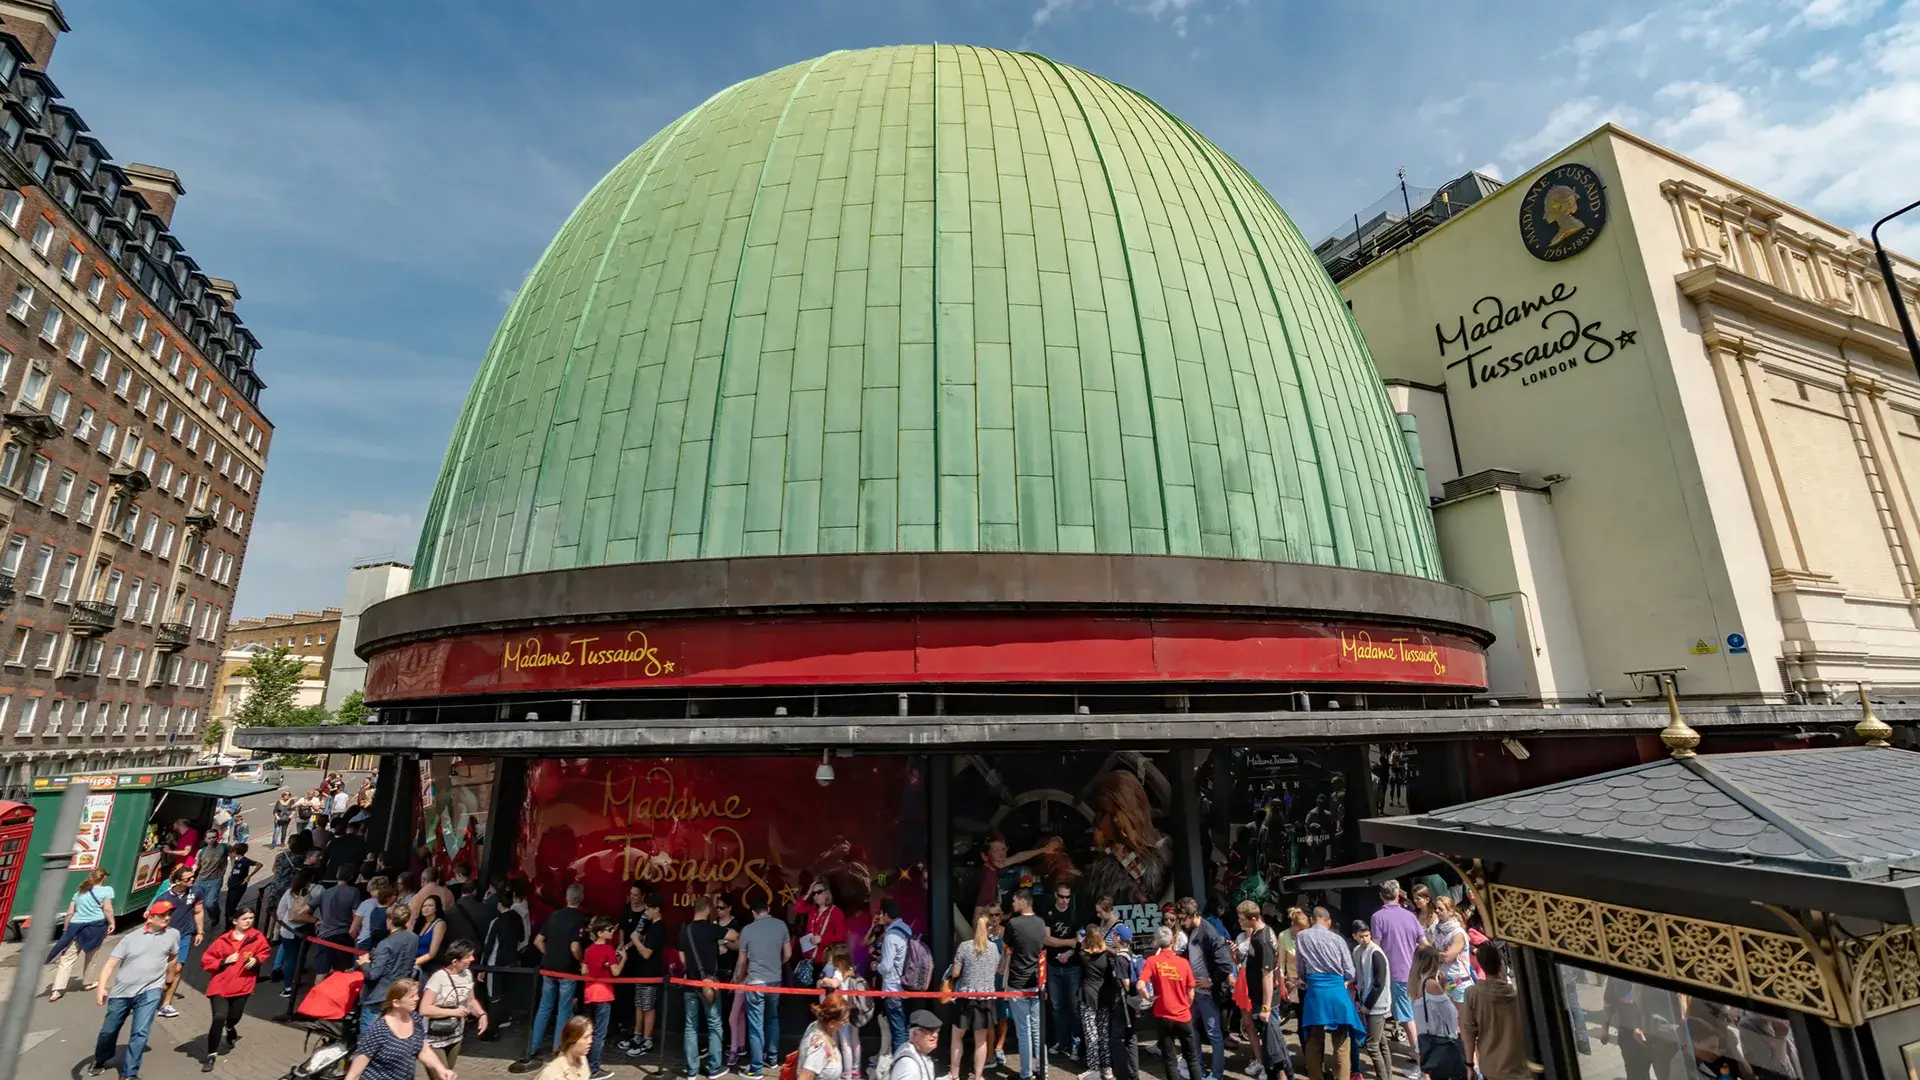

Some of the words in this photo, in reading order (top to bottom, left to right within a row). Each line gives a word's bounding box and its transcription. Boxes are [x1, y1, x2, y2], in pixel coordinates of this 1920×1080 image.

[1523, 178, 1550, 248] MADAME
[1554, 167, 1601, 212] TUSSAUD
[1543, 227, 1595, 258] 1761-1850
[1435, 282, 1577, 356] Madame
[1446, 309, 1615, 389] Tussauds
[1521, 357, 1578, 387] LONDON
[503, 637, 574, 672] Madame
[570, 630, 662, 676] Tussauds
[1341, 630, 1397, 662] Madame
[1391, 635, 1442, 675] Tussauds
[1246, 753, 1273, 767] Madame
[1271, 752, 1298, 765] Tussauds
[603, 766, 751, 828] Madame
[604, 826, 773, 910] Tussauds
[1119, 917, 1162, 934] ARS
